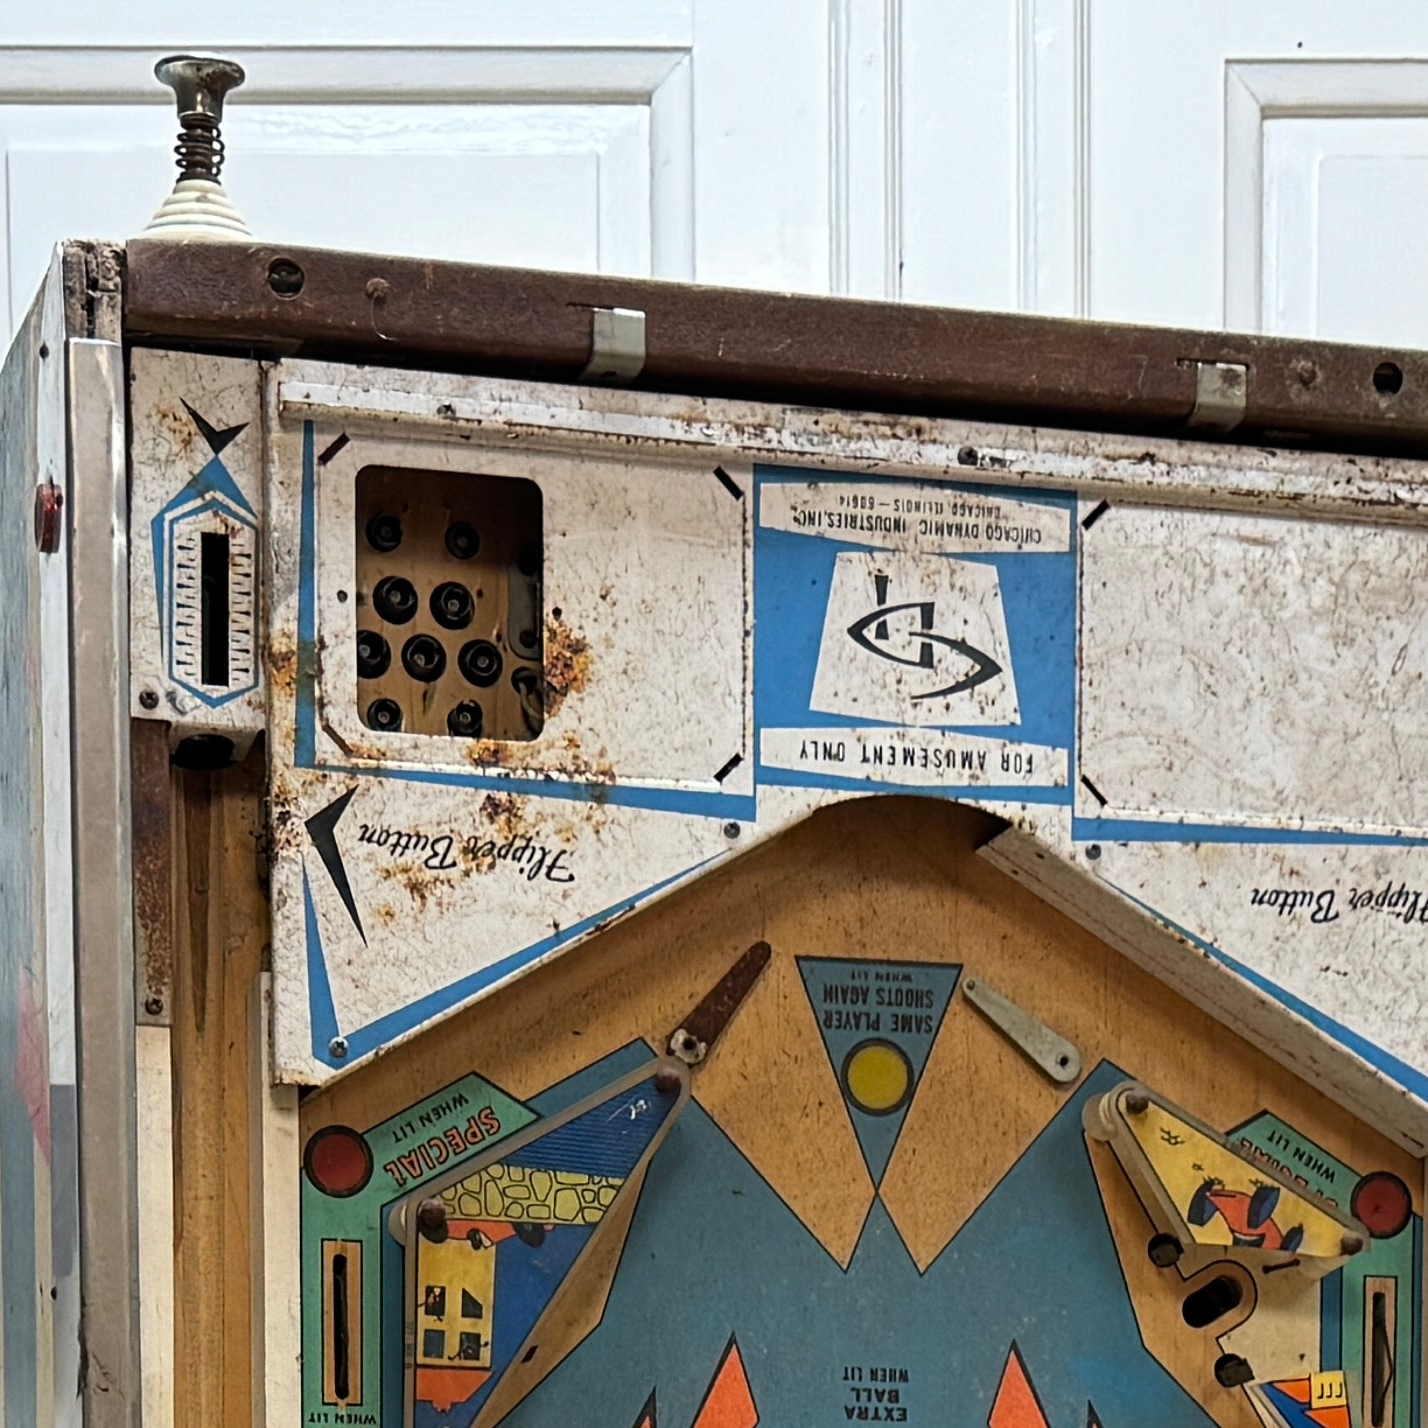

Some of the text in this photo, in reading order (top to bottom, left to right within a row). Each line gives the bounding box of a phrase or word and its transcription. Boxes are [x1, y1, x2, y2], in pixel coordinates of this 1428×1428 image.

[893, 498, 943, 516] ILLINOIS
[919, 519, 979, 539] DYNAMIC
[985, 522, 1041, 544] CHICAGO
[800, 740, 1033, 774] FOR AMUSEMENT ONLY
[357, 823, 575, 882] Flipper Button
[1251, 887, 1339, 923] Button
[875, 971, 914, 983] WHEN
[823, 984, 934, 1009] SHOOTS AGAIN
[823, 1010, 934, 1035] SAME PLAYER
[392, 1092, 469, 1144] WHEN LIT
[383, 1106, 502, 1188] SPECIAL
[1267, 1130, 1336, 1184] WHEN LIT
[843, 1366, 909, 1383] WHEN LIT
[850, 1387, 900, 1404] BALL
[308, 1413, 377, 1425] WHEN LIT
[844, 1405, 907, 1422] EXTRA
